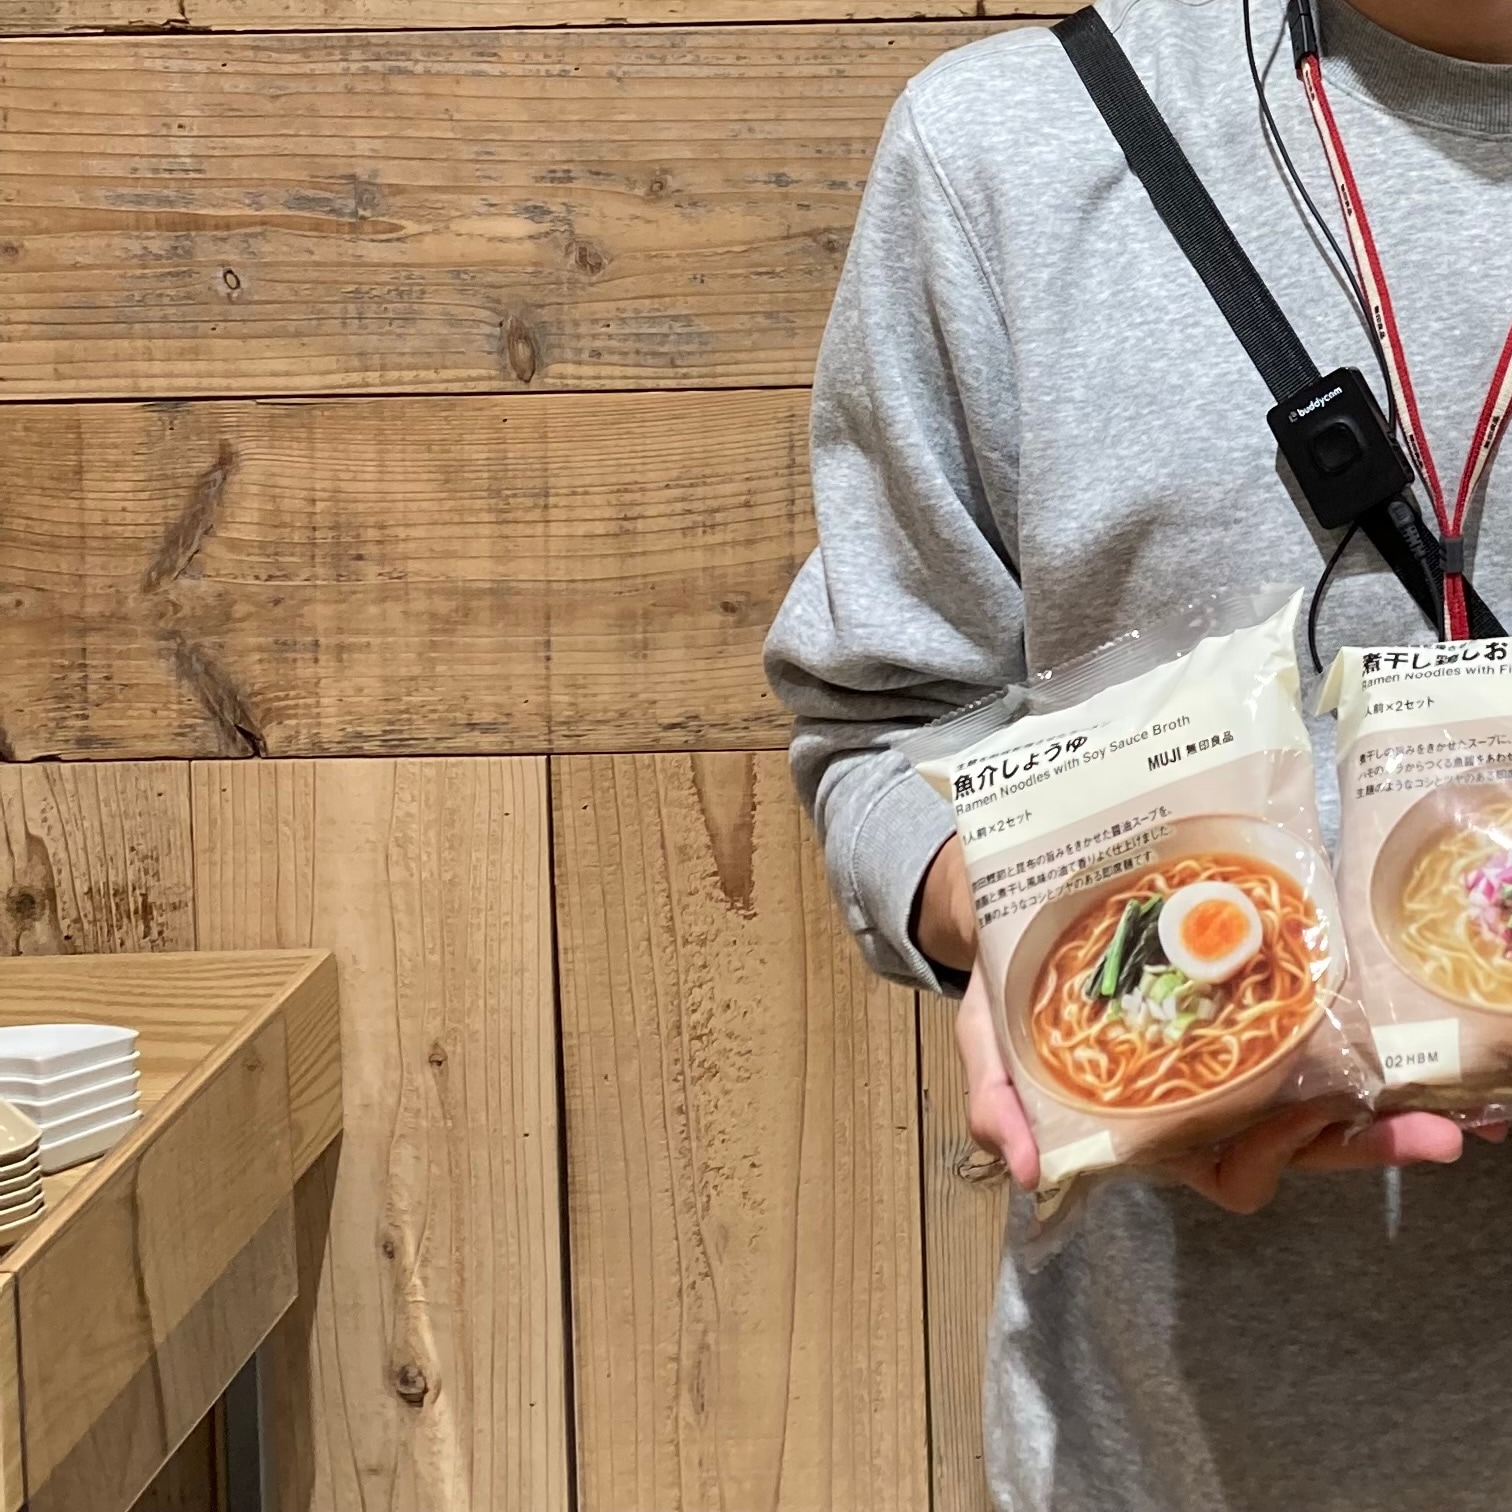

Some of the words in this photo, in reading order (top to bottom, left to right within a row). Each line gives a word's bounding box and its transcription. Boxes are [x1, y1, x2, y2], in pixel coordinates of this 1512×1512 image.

[1361, 672, 1400, 691] Ramen
[1404, 666, 1461, 682] Noodles
[1464, 662, 1496, 678] with
[1364, 694, 1435, 718] 人前×2セット
[954, 735, 1088, 800] 魚介しょうゆ
[955, 792, 998, 817] Ramen
[1000, 769, 1051, 800] Noodles
[1054, 756, 1081, 784] with
[1082, 746, 1106, 771] Soy
[1109, 731, 1149, 756] Sauce
[1152, 714, 1191, 738] Broth
[1148, 746, 1182, 772] MUJI
[1186, 730, 1235, 757] 無印良品
